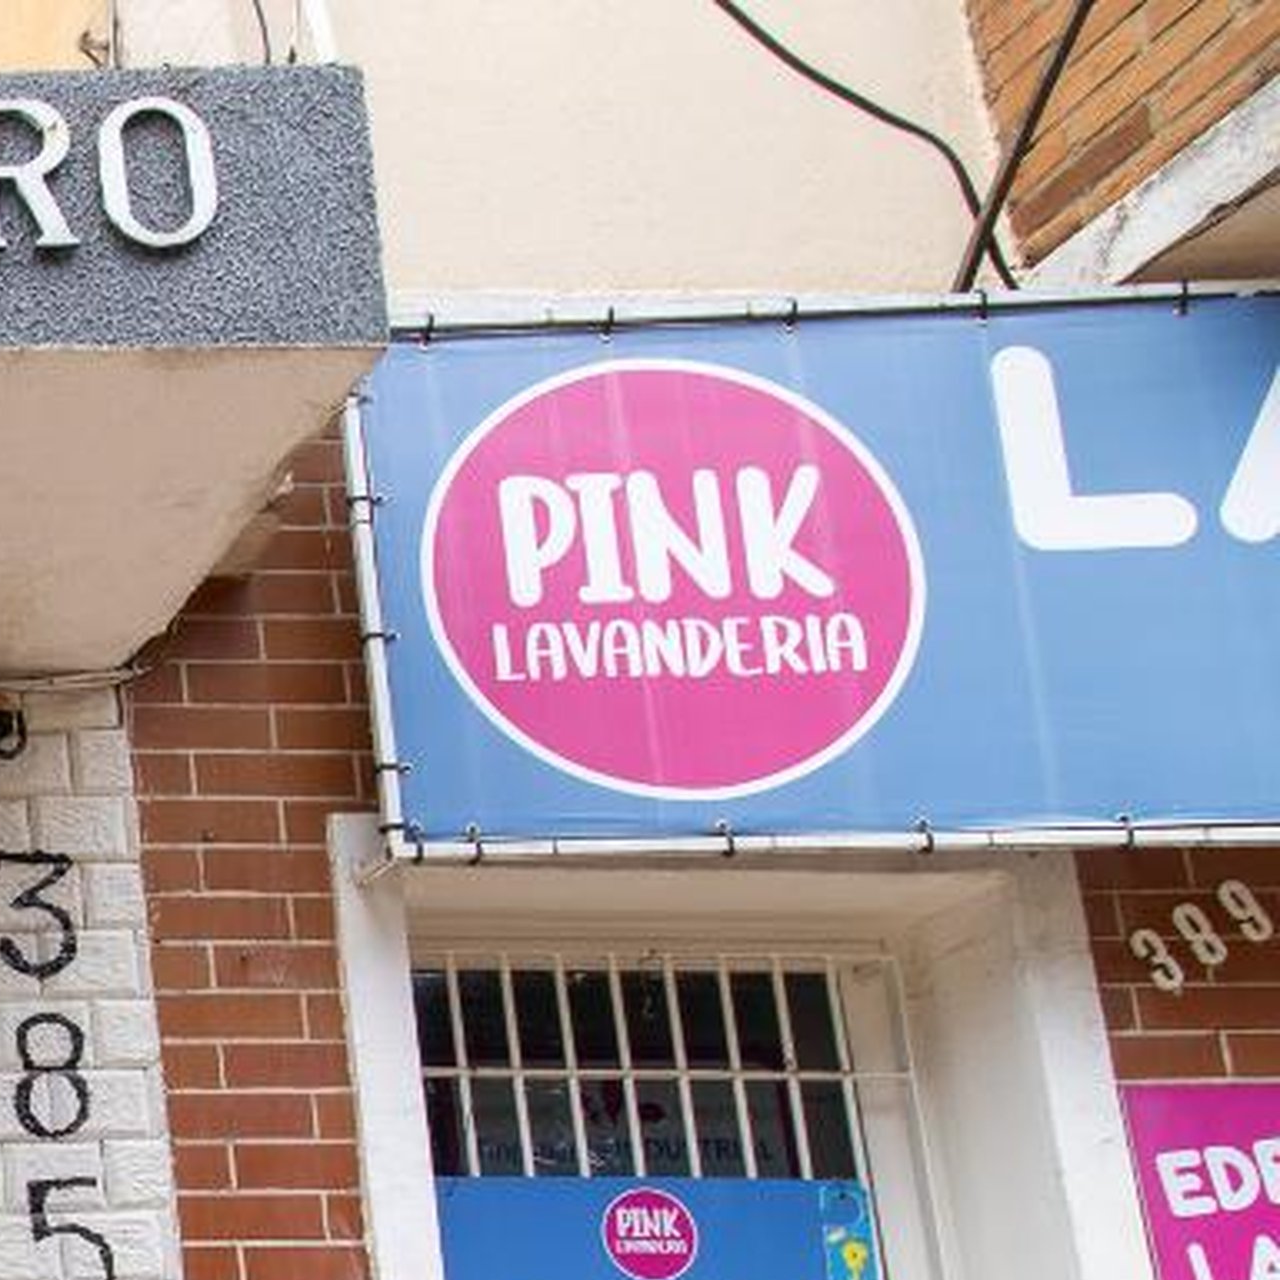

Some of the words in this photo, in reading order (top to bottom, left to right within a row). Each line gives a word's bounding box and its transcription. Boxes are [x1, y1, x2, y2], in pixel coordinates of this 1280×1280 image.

[498, 464, 835, 608] PINK
[490, 611, 868, 683] LAVANDERIA
[1129, 880, 1273, 994] 389
[616, 1207, 681, 1237] PINK
